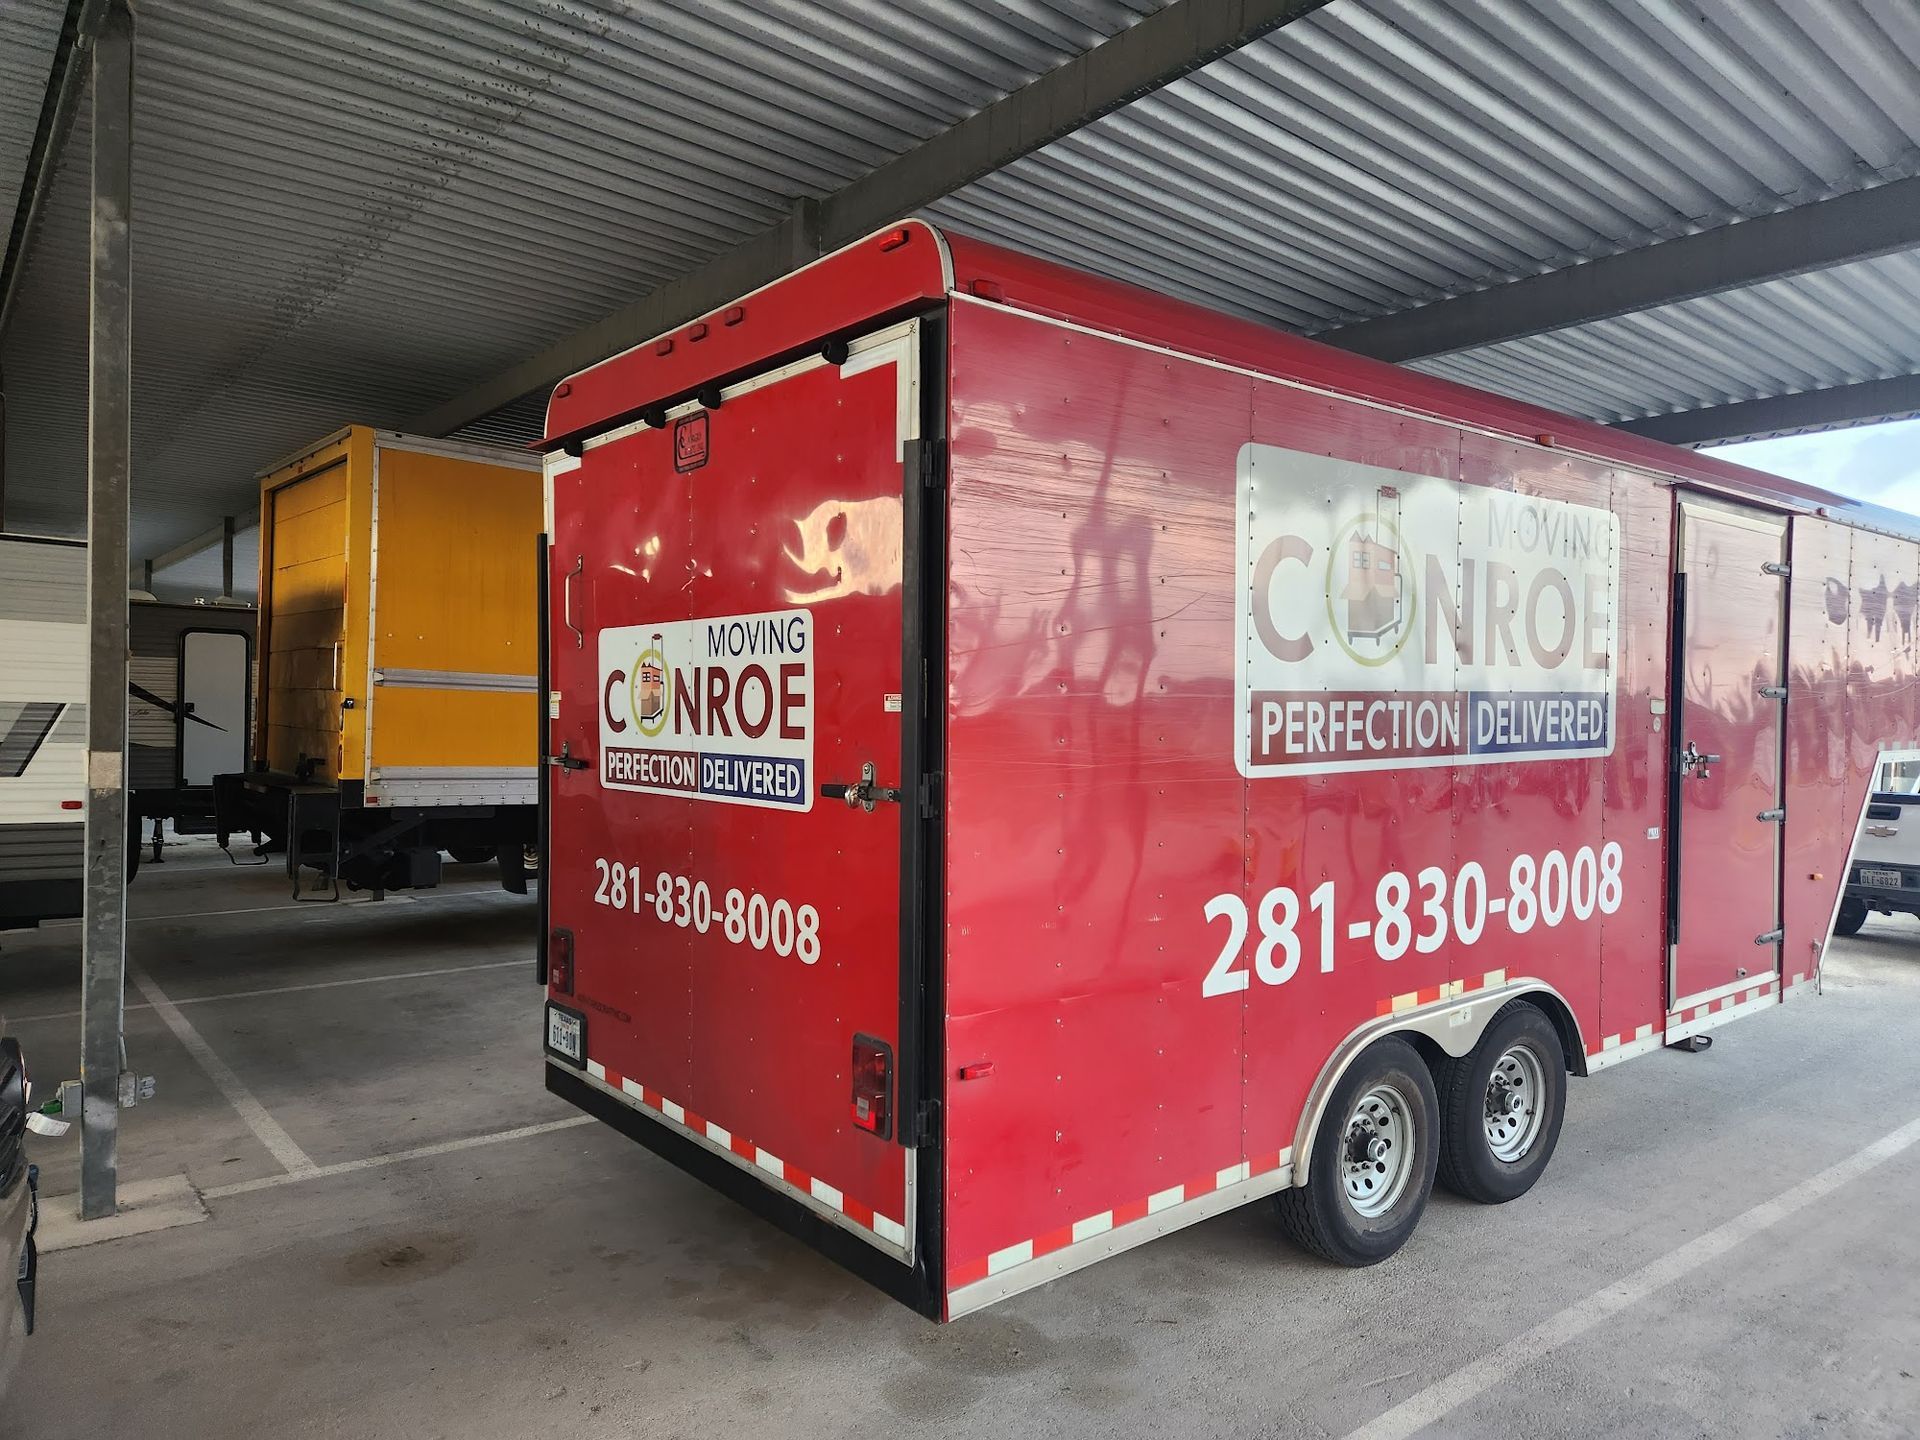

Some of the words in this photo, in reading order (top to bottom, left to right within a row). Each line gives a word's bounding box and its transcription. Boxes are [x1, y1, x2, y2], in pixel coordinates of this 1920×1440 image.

[1487, 497, 1613, 563] MOVING
[1251, 513, 1611, 670] CONROE
[707, 616, 806, 658] MOVING
[604, 649, 806, 741] CONROE
[1261, 700, 1461, 756] PERFECTION
[1477, 700, 1604, 747] DELIVERED
[607, 751, 696, 787] PERFECTION
[702, 756, 801, 798] DELIVERED
[594, 857, 822, 965] 281-830-8008
[1202, 840, 1624, 998] 281-830-8008
